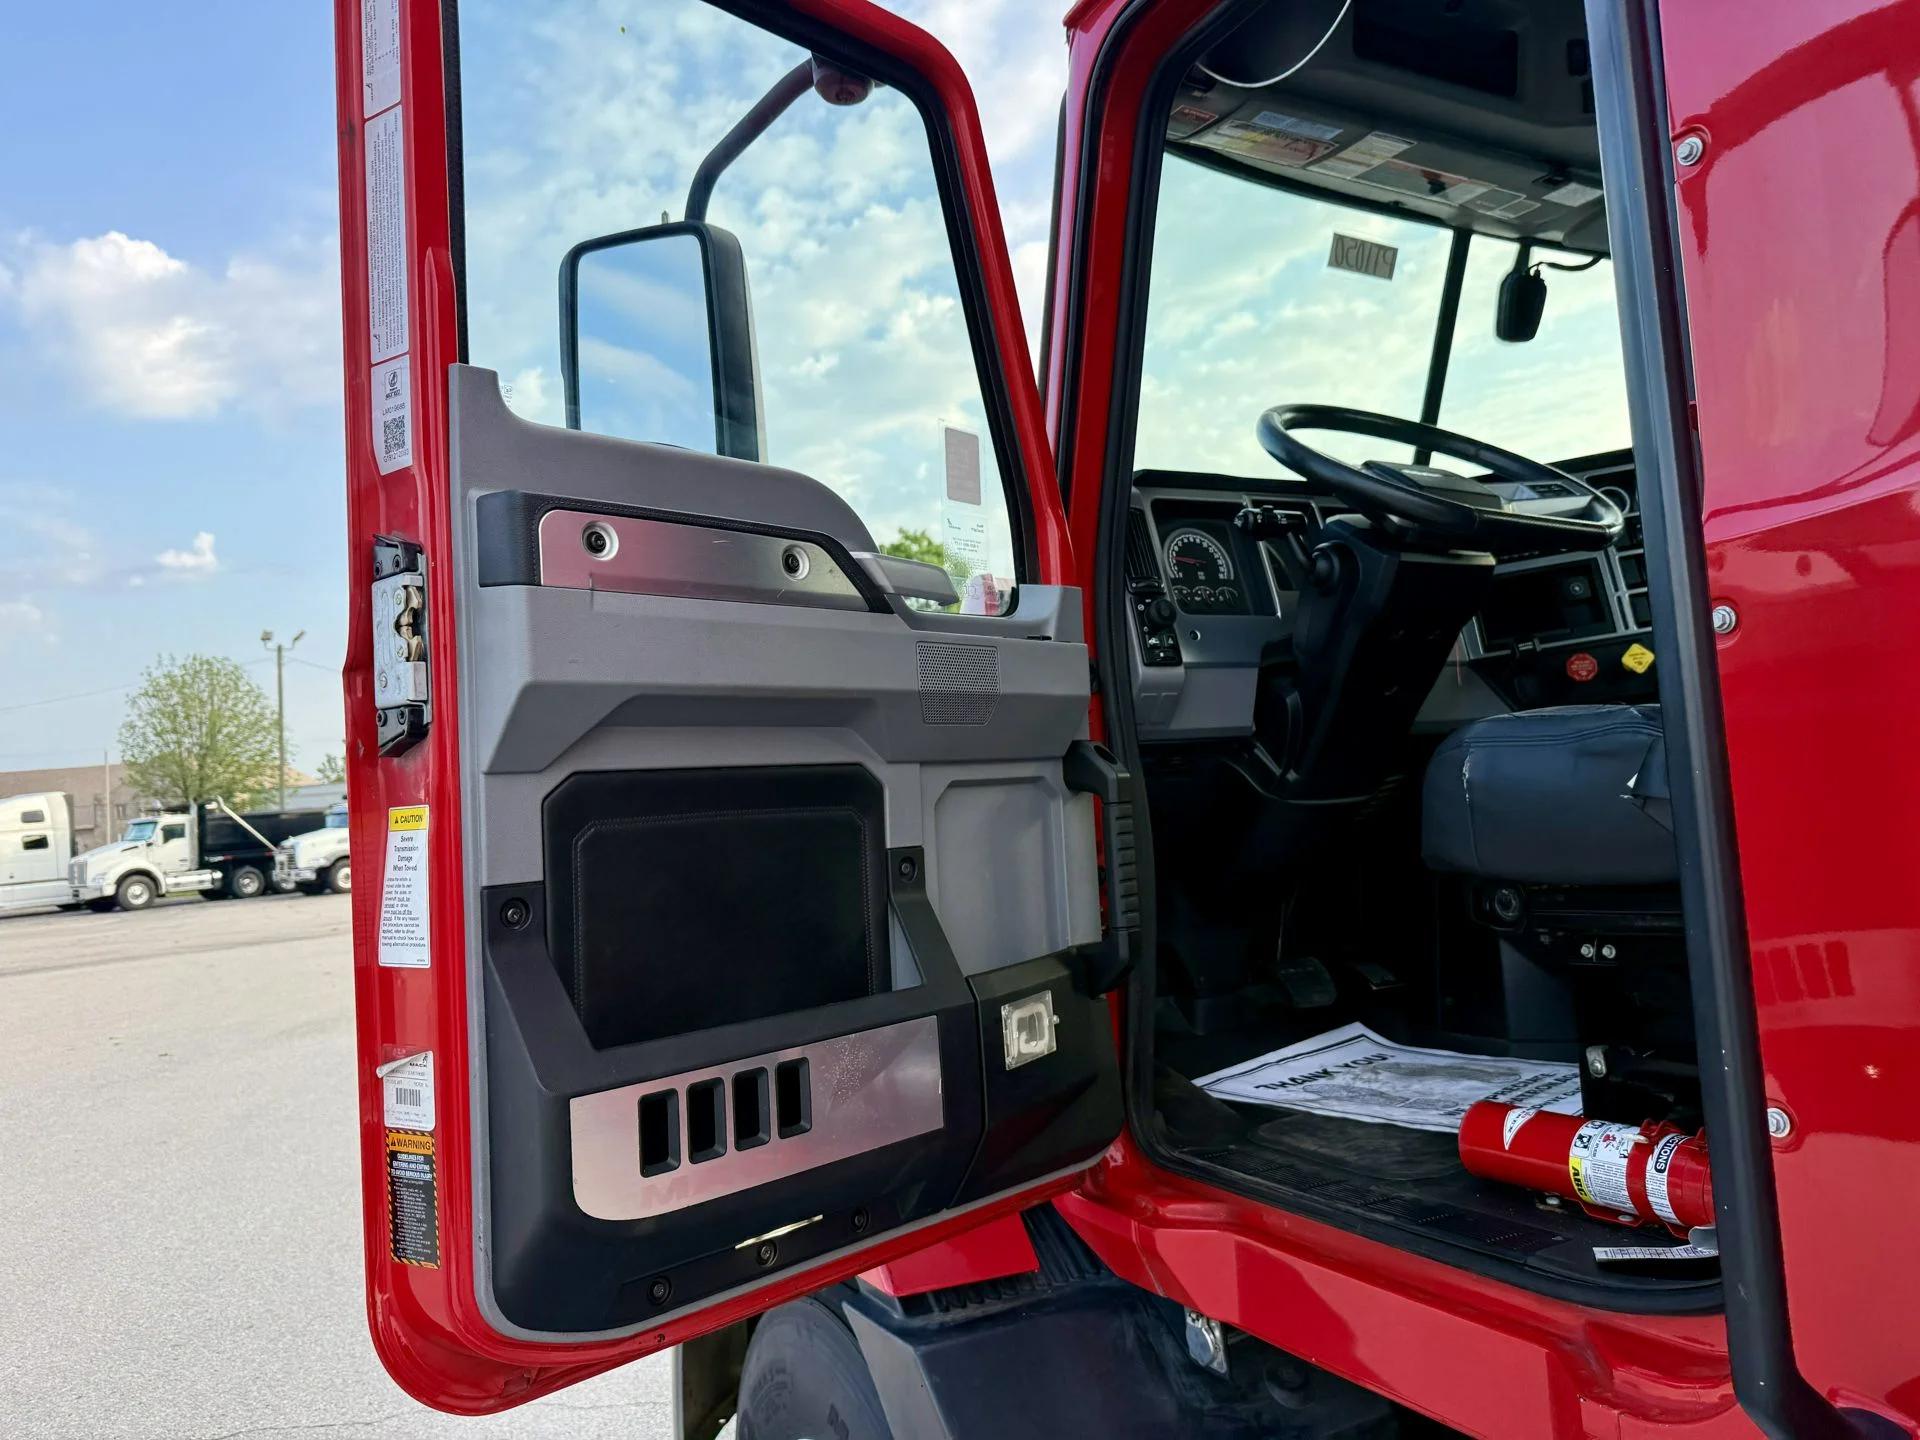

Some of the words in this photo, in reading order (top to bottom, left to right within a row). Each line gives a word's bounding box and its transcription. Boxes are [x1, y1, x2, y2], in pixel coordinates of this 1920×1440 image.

[400, 814, 423, 824] CAUTION
[400, 835, 414, 843] Severe
[397, 854, 413, 863] Damage
[1253, 1068, 1343, 1090] THANK
[396, 1137, 431, 1151] WARNING
[1571, 1165, 1588, 1197] ABC
